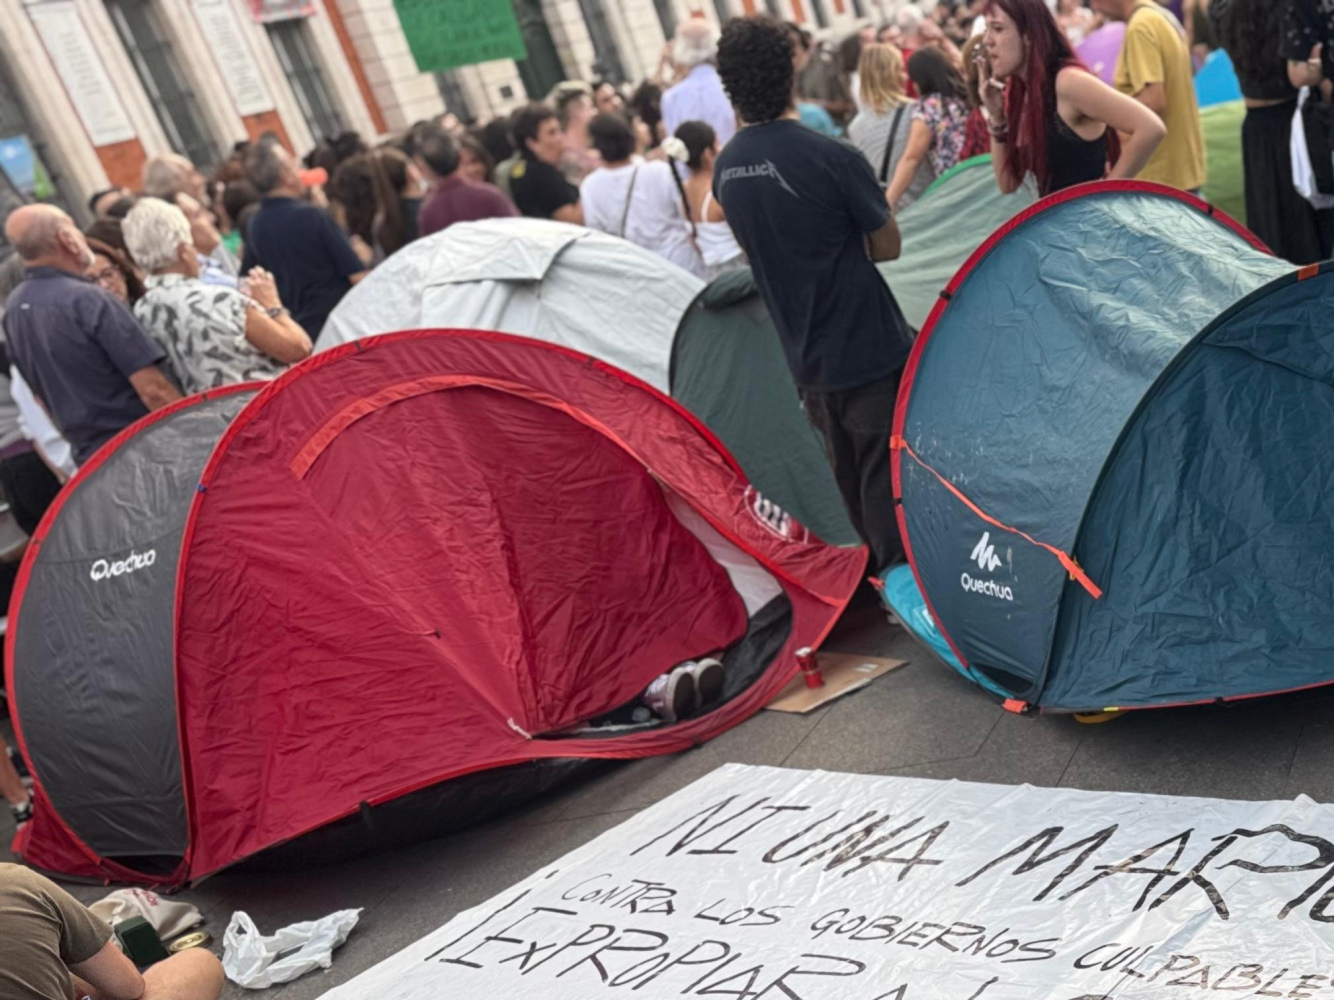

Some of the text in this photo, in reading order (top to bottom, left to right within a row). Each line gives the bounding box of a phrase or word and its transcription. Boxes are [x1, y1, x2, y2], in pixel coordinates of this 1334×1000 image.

[90, 549, 156, 582] Quechua
[961, 572, 1013, 601] Quechua
[630, 794, 809, 856] NI
[762, 810, 949, 882] UNA
[561, 873, 677, 915] CONTRA
[693, 898, 794, 926] LOS
[810, 908, 1063, 963] GOBIERNOS
